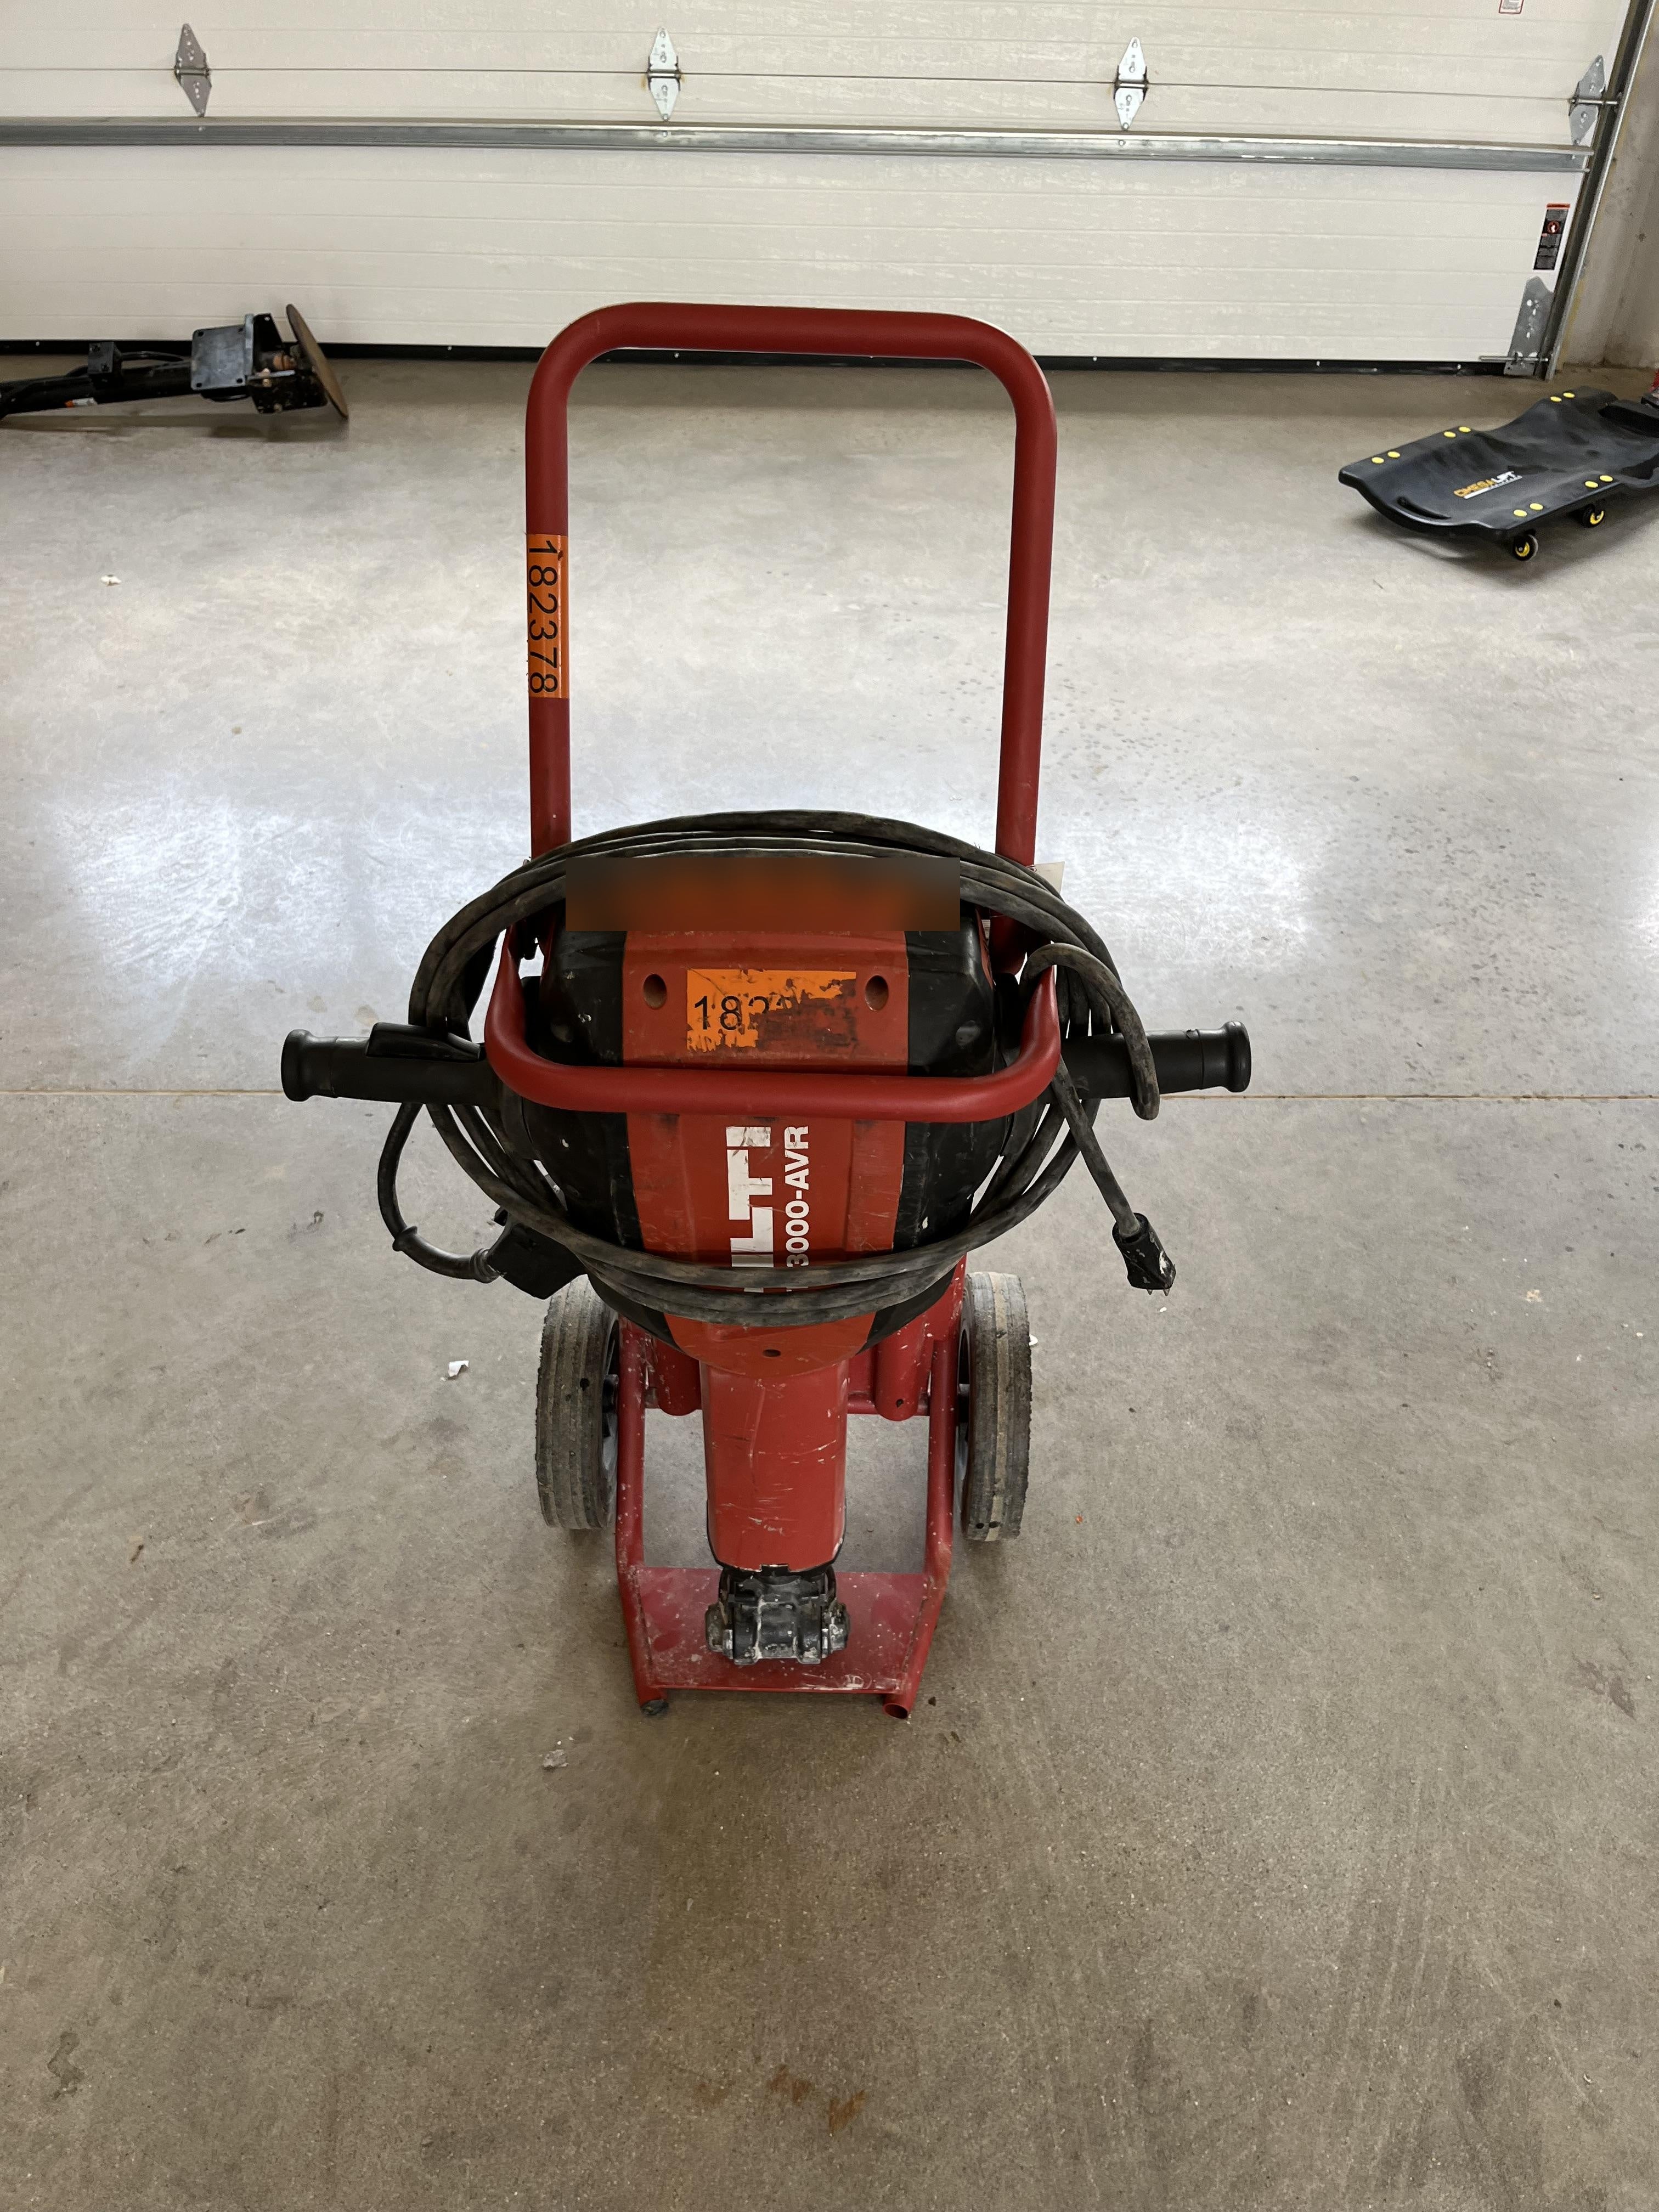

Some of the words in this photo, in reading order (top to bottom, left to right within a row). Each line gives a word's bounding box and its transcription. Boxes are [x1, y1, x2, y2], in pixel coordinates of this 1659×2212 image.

[528, 540, 558, 693] 182378
[726, 1126, 774, 1293] ILTI
[784, 1126, 809, 1268] 3000-AVR
